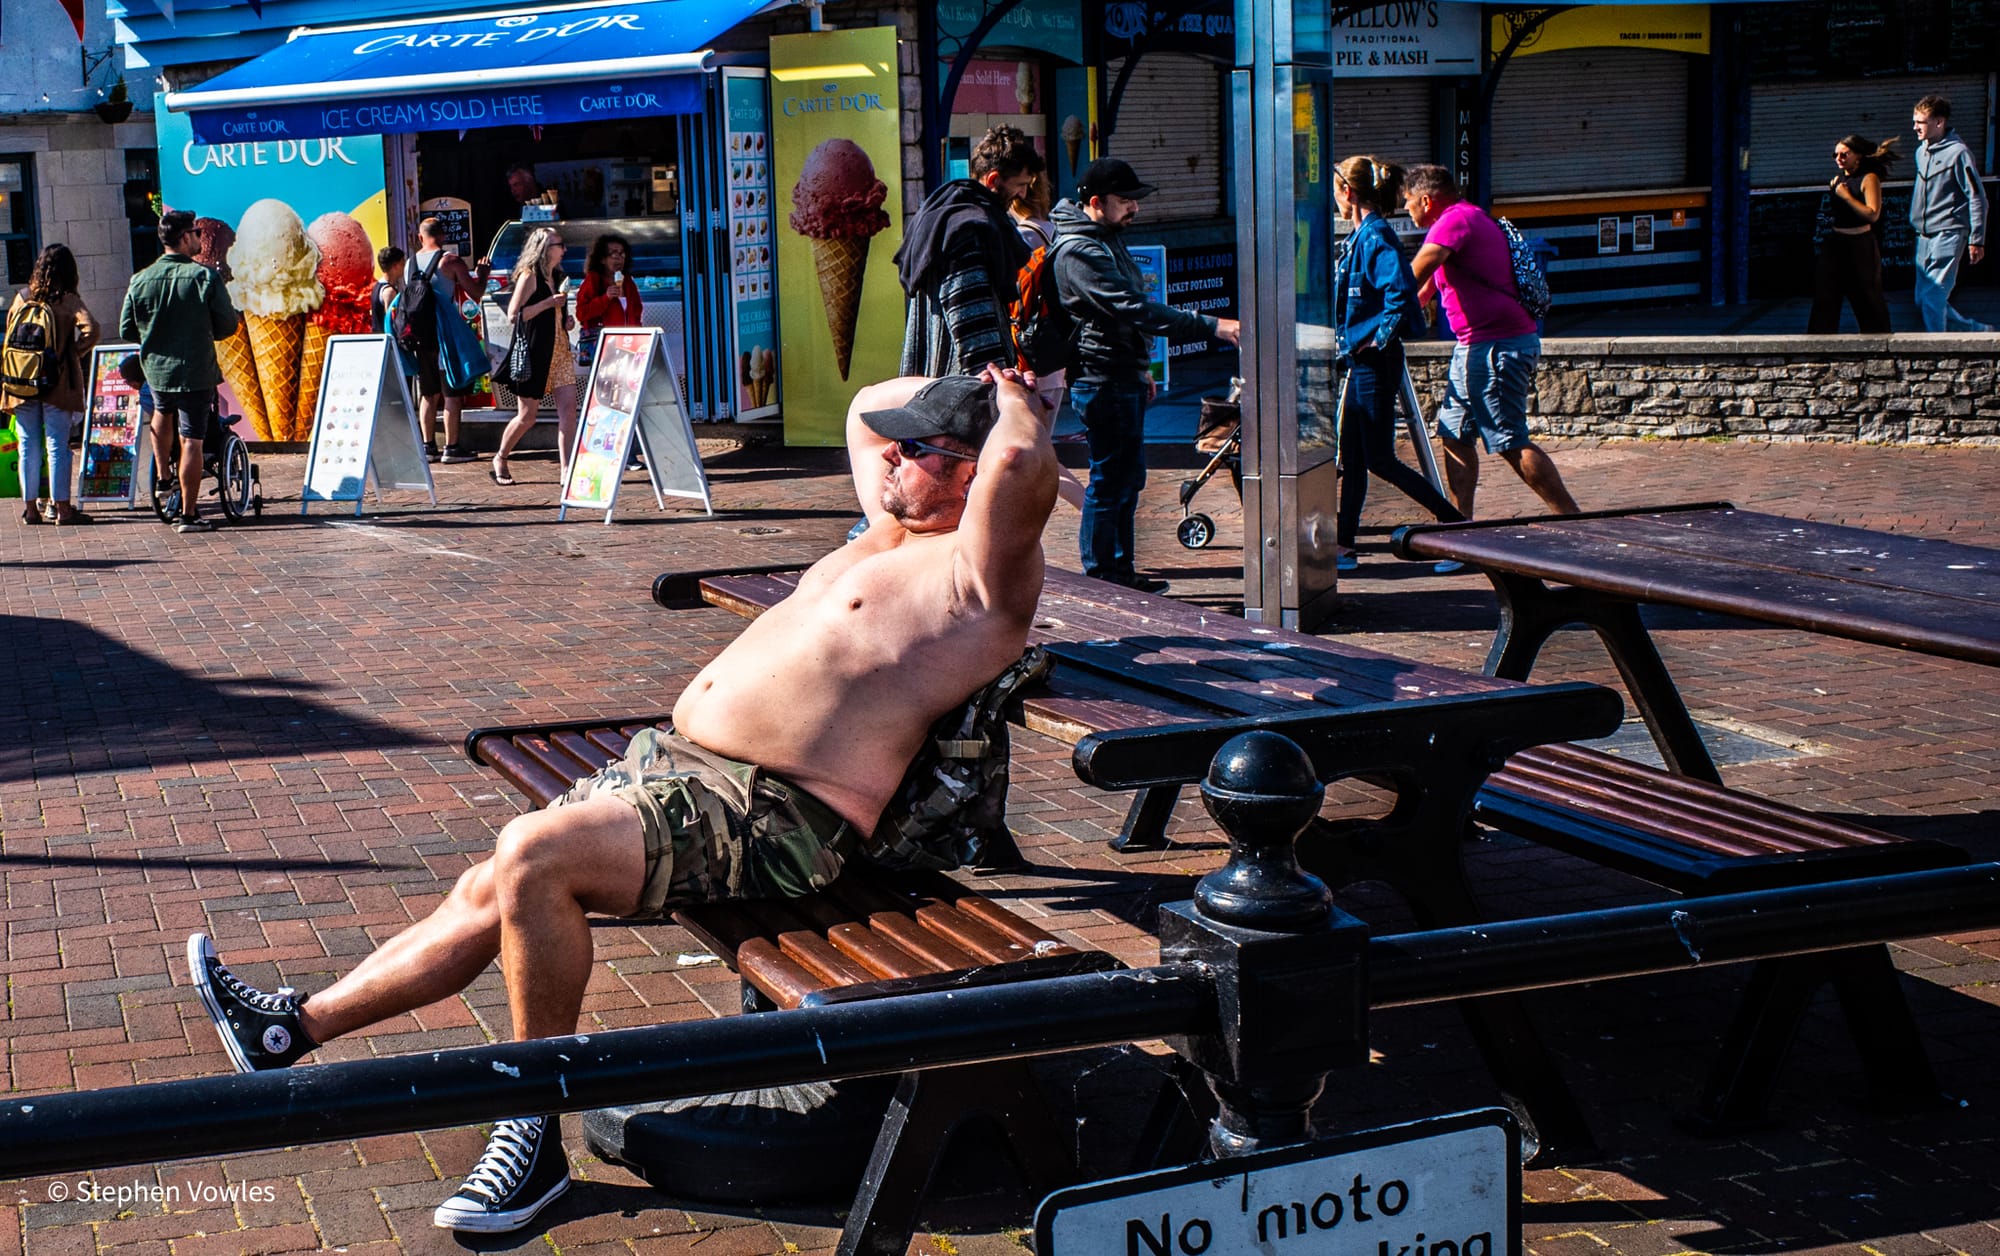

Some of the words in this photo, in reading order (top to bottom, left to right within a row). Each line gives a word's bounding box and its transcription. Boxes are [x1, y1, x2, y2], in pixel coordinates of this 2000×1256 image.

[353, 32, 510, 55] CARTE
[515, 14, 645, 44] D'OR
[1205, 14, 1234, 37] QUA
[1345, 35, 1420, 44] TRADITIONAL
[1336, 51, 1362, 66] PIE
[1368, 52, 1381, 66] &
[1384, 50, 1429, 66] MASH
[321, 109, 351, 129] ICE
[356, 103, 425, 128] CREAM
[430, 99, 486, 122] SOLD
[492, 95, 544, 117] HERE
[579, 96, 622, 112] CARTE
[625, 92, 663, 109] D'OR
[783, 96, 836, 117] CARTE
[841, 92, 888, 112] D'OR
[222, 121, 256, 137] CARTE
[259, 119, 291, 135] D'OR
[183, 138, 268, 175] CARTE
[278, 136, 358, 168] DOR
[1459, 109, 1471, 186] MASH
[1168, 256, 1184, 273] ISH
[1194, 252, 1234, 271] SEAFOOD
[1168, 281, 1189, 294] ACKET
[1190, 277, 1224, 291] POTATOES
[1200, 297, 1231, 311] SEAFOOD
[1168, 345, 1181, 357] OLD
[1182, 341, 1208, 355] DRINKS
[1127, 1213, 1213, 1256] No
